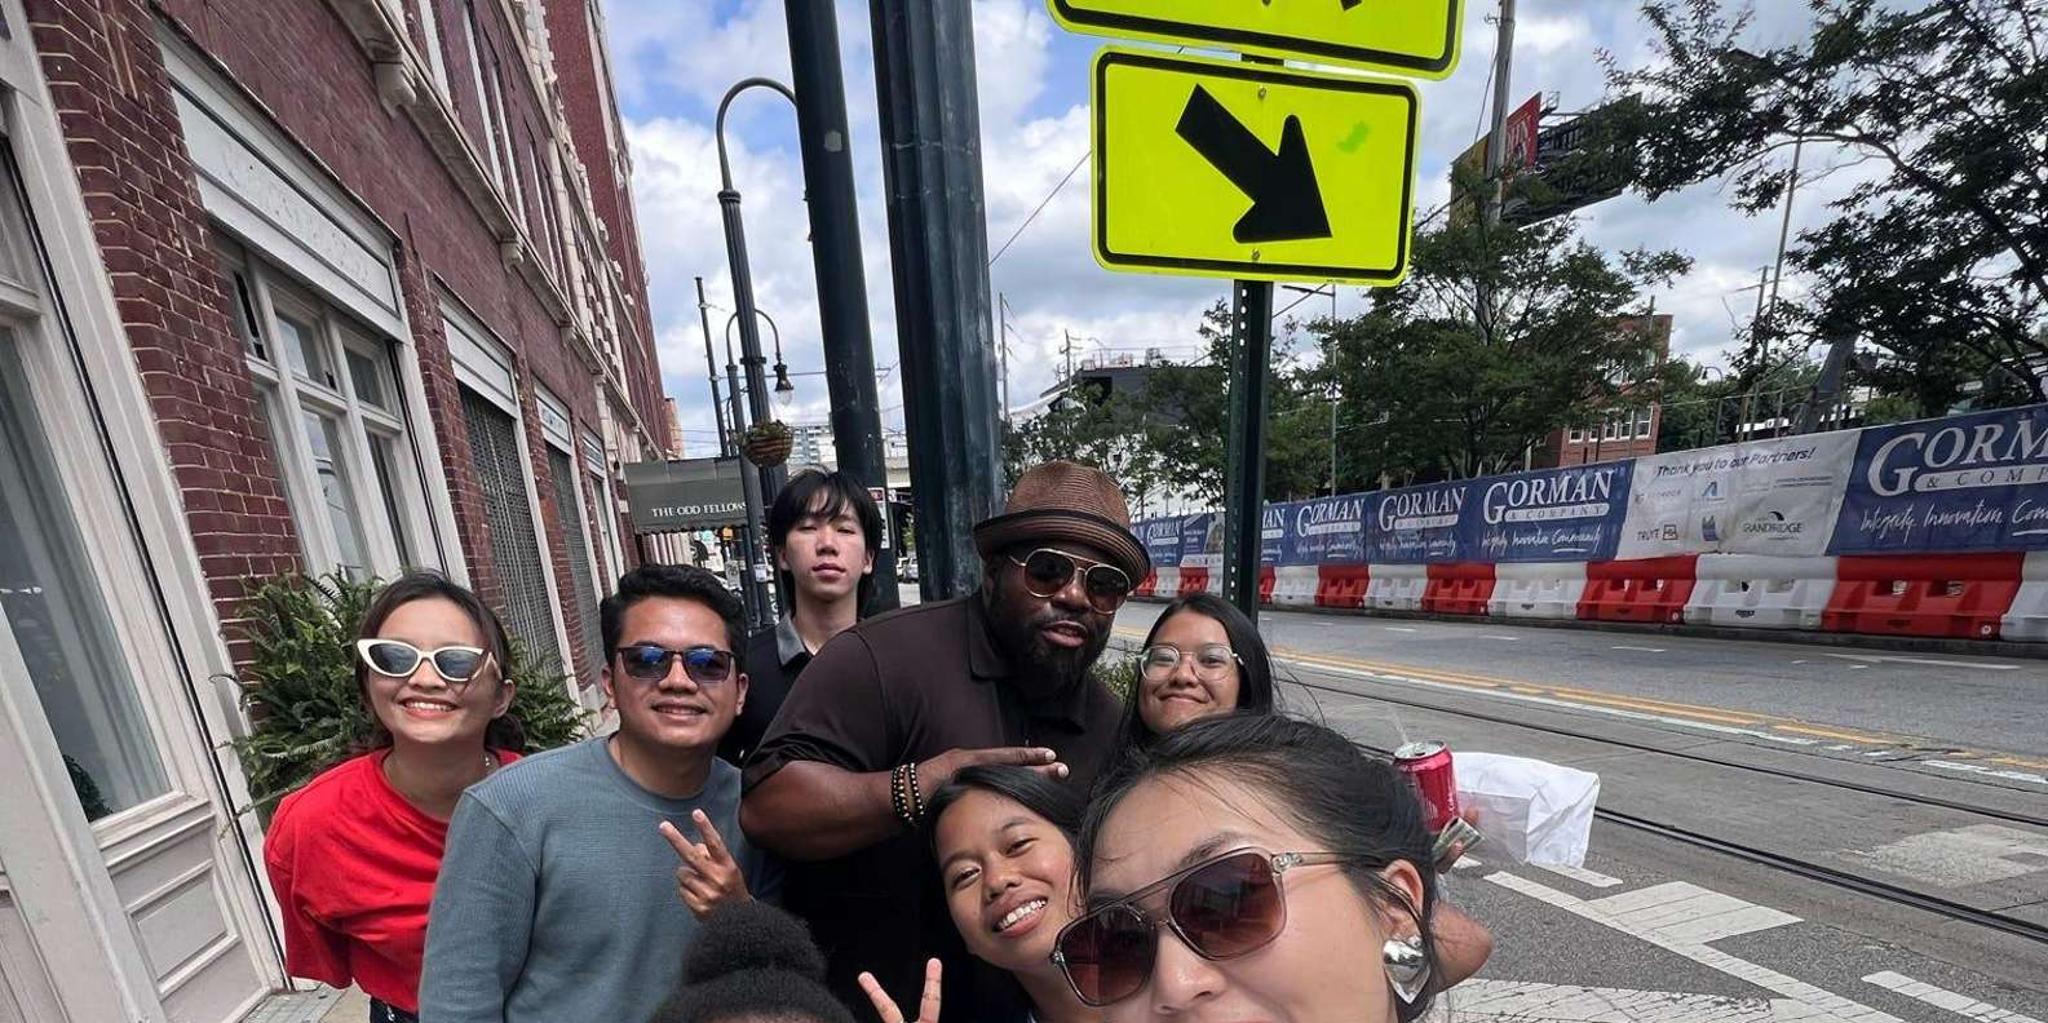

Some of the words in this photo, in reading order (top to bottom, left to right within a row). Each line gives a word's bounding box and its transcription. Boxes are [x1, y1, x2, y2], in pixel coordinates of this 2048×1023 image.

[1656, 462, 1690, 477] Thank
[1689, 460, 1713, 477] you
[1713, 458, 1728, 469] to
[1749, 446, 1817, 465] Partners!
[1483, 470, 1615, 524] GORMAN
[1926, 475, 1941, 489] &
[651, 506, 673, 517] THE
[676, 505, 700, 515] ODD
[1297, 499, 1365, 537] GORMAN
[1379, 487, 1467, 532] GORMAN
